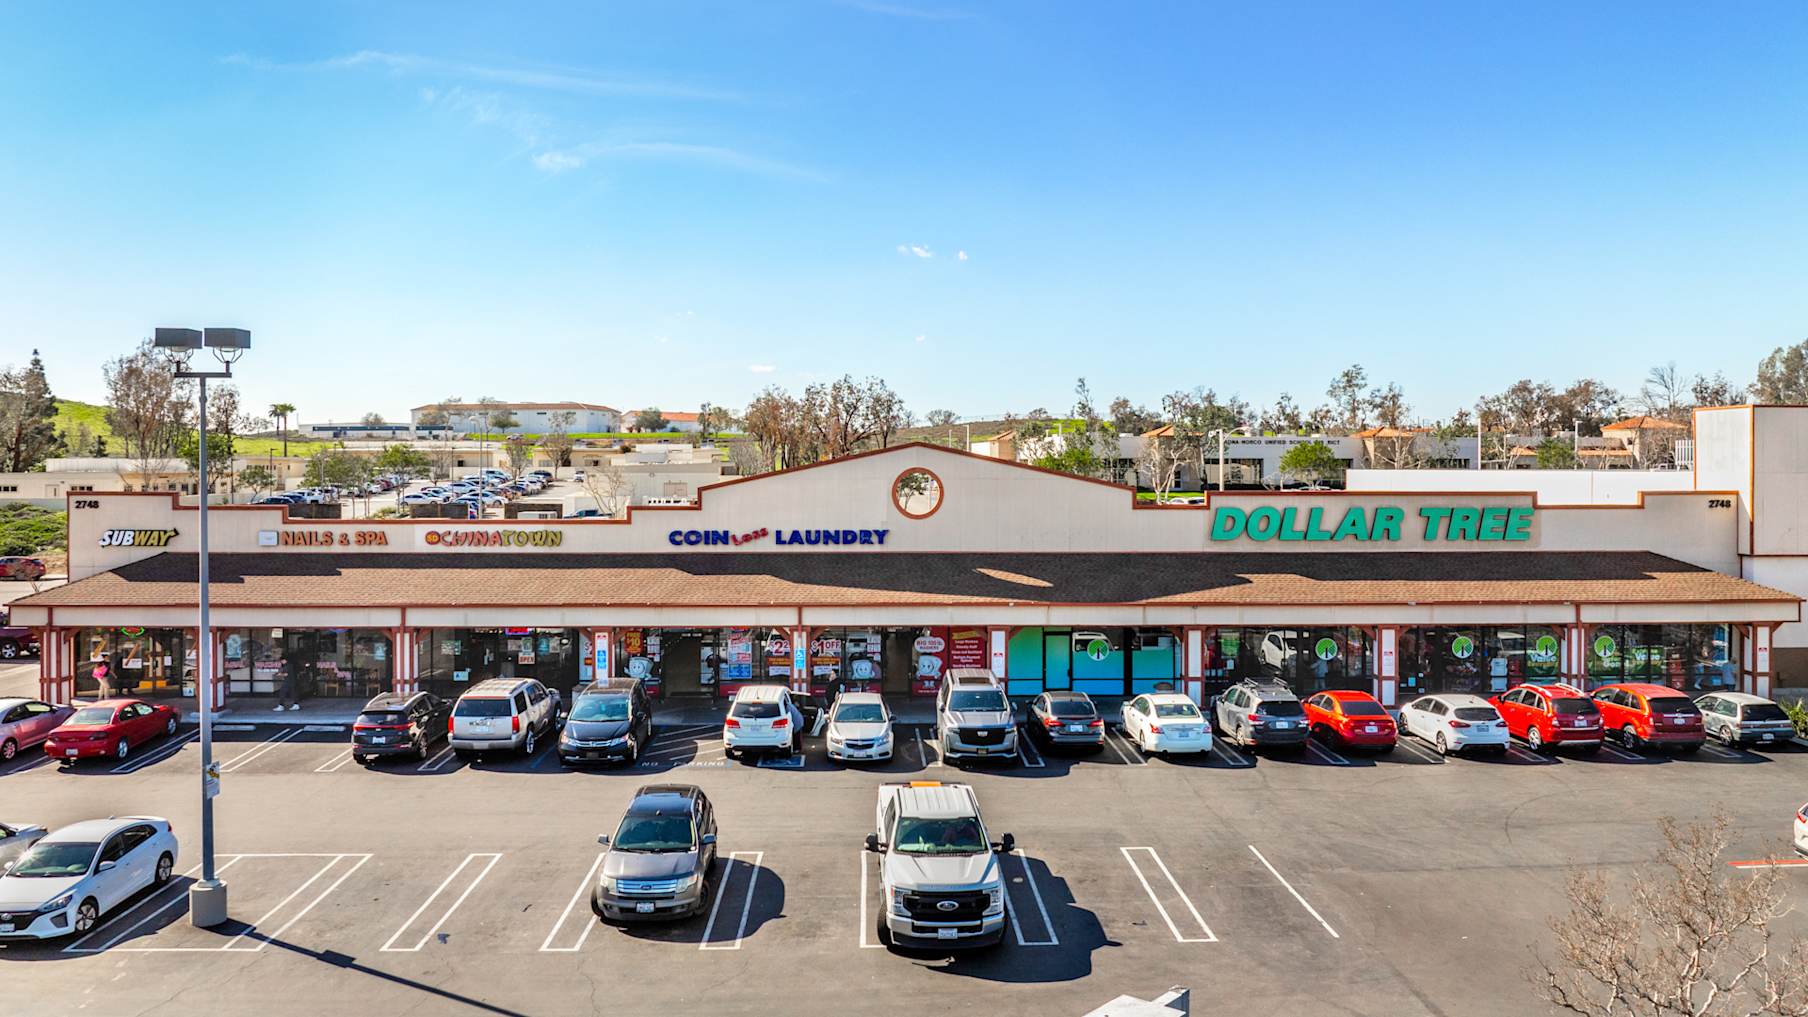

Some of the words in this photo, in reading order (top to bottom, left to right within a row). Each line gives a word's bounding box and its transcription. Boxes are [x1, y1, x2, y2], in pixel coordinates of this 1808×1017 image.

[75, 500, 99, 509] 2748
[1708, 499, 1731, 508] 2748
[1210, 506, 1405, 541] DOLLAR
[1419, 506, 1535, 541] TREE
[98, 528, 179, 548] SUBWAY
[280, 530, 334, 546] NAILS
[338, 533, 350, 546] &
[354, 530, 389, 546] SPA
[440, 529, 563, 547] CHINATOWN
[668, 529, 730, 546] COIN
[775, 529, 889, 545] LAUNDRY
[825, 641, 840, 649] OFF
[1530, 654, 1557, 662] Value
